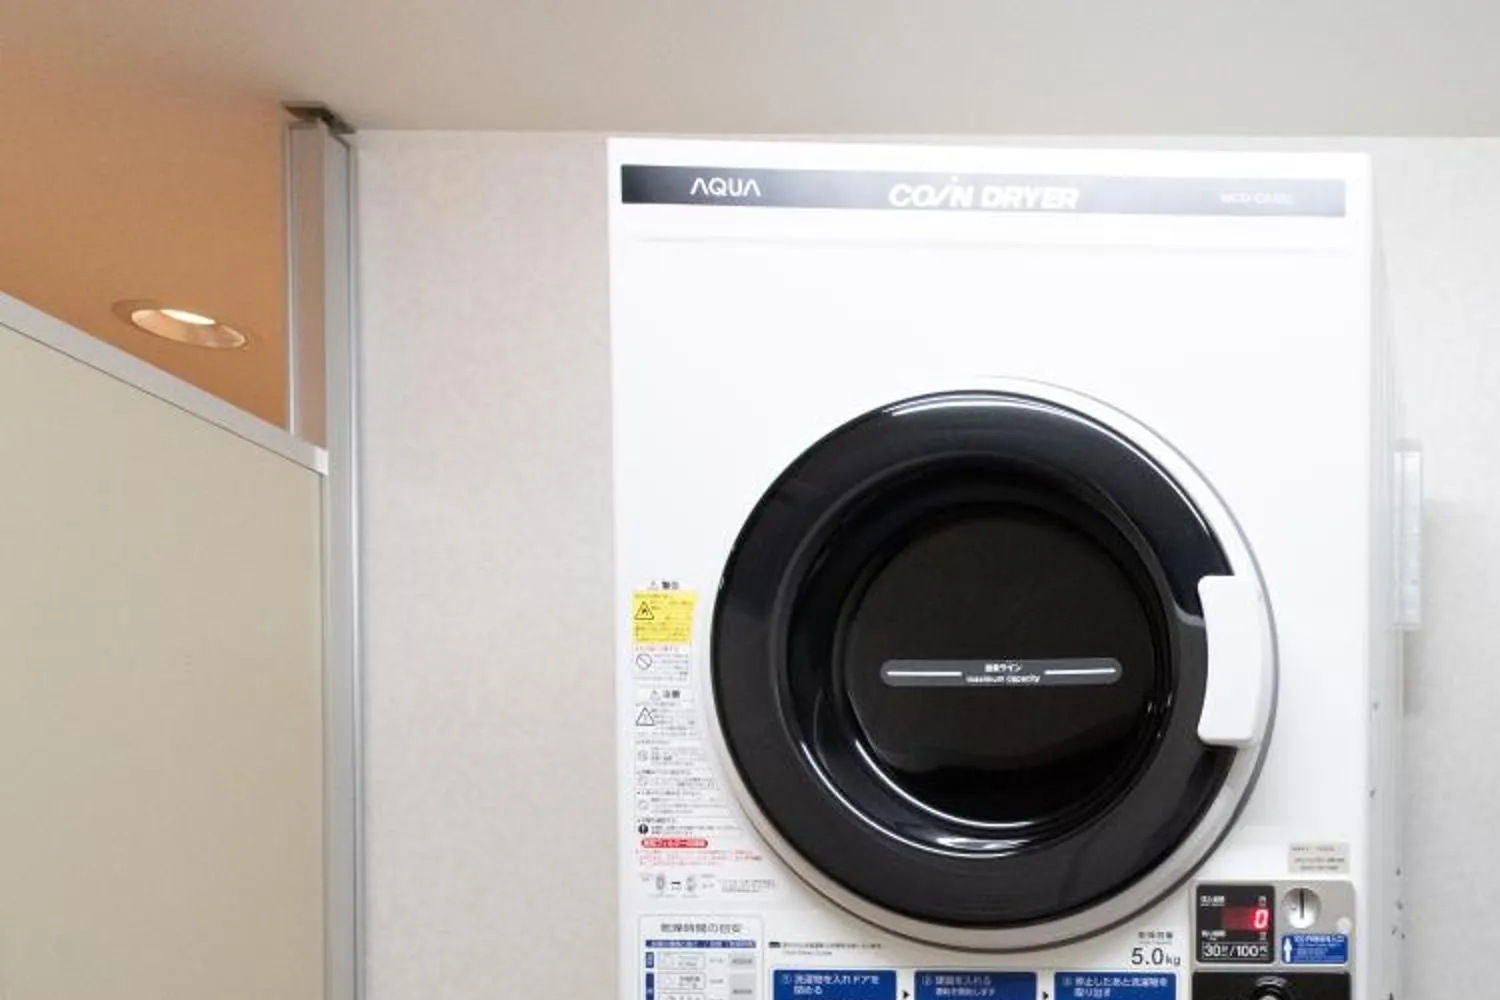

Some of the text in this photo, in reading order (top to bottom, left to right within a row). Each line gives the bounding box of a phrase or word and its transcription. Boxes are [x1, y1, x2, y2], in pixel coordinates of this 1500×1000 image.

[690, 177, 761, 197] AQUA
[980, 184, 1080, 209] DRYER
[1253, 908, 1270, 930] 0
